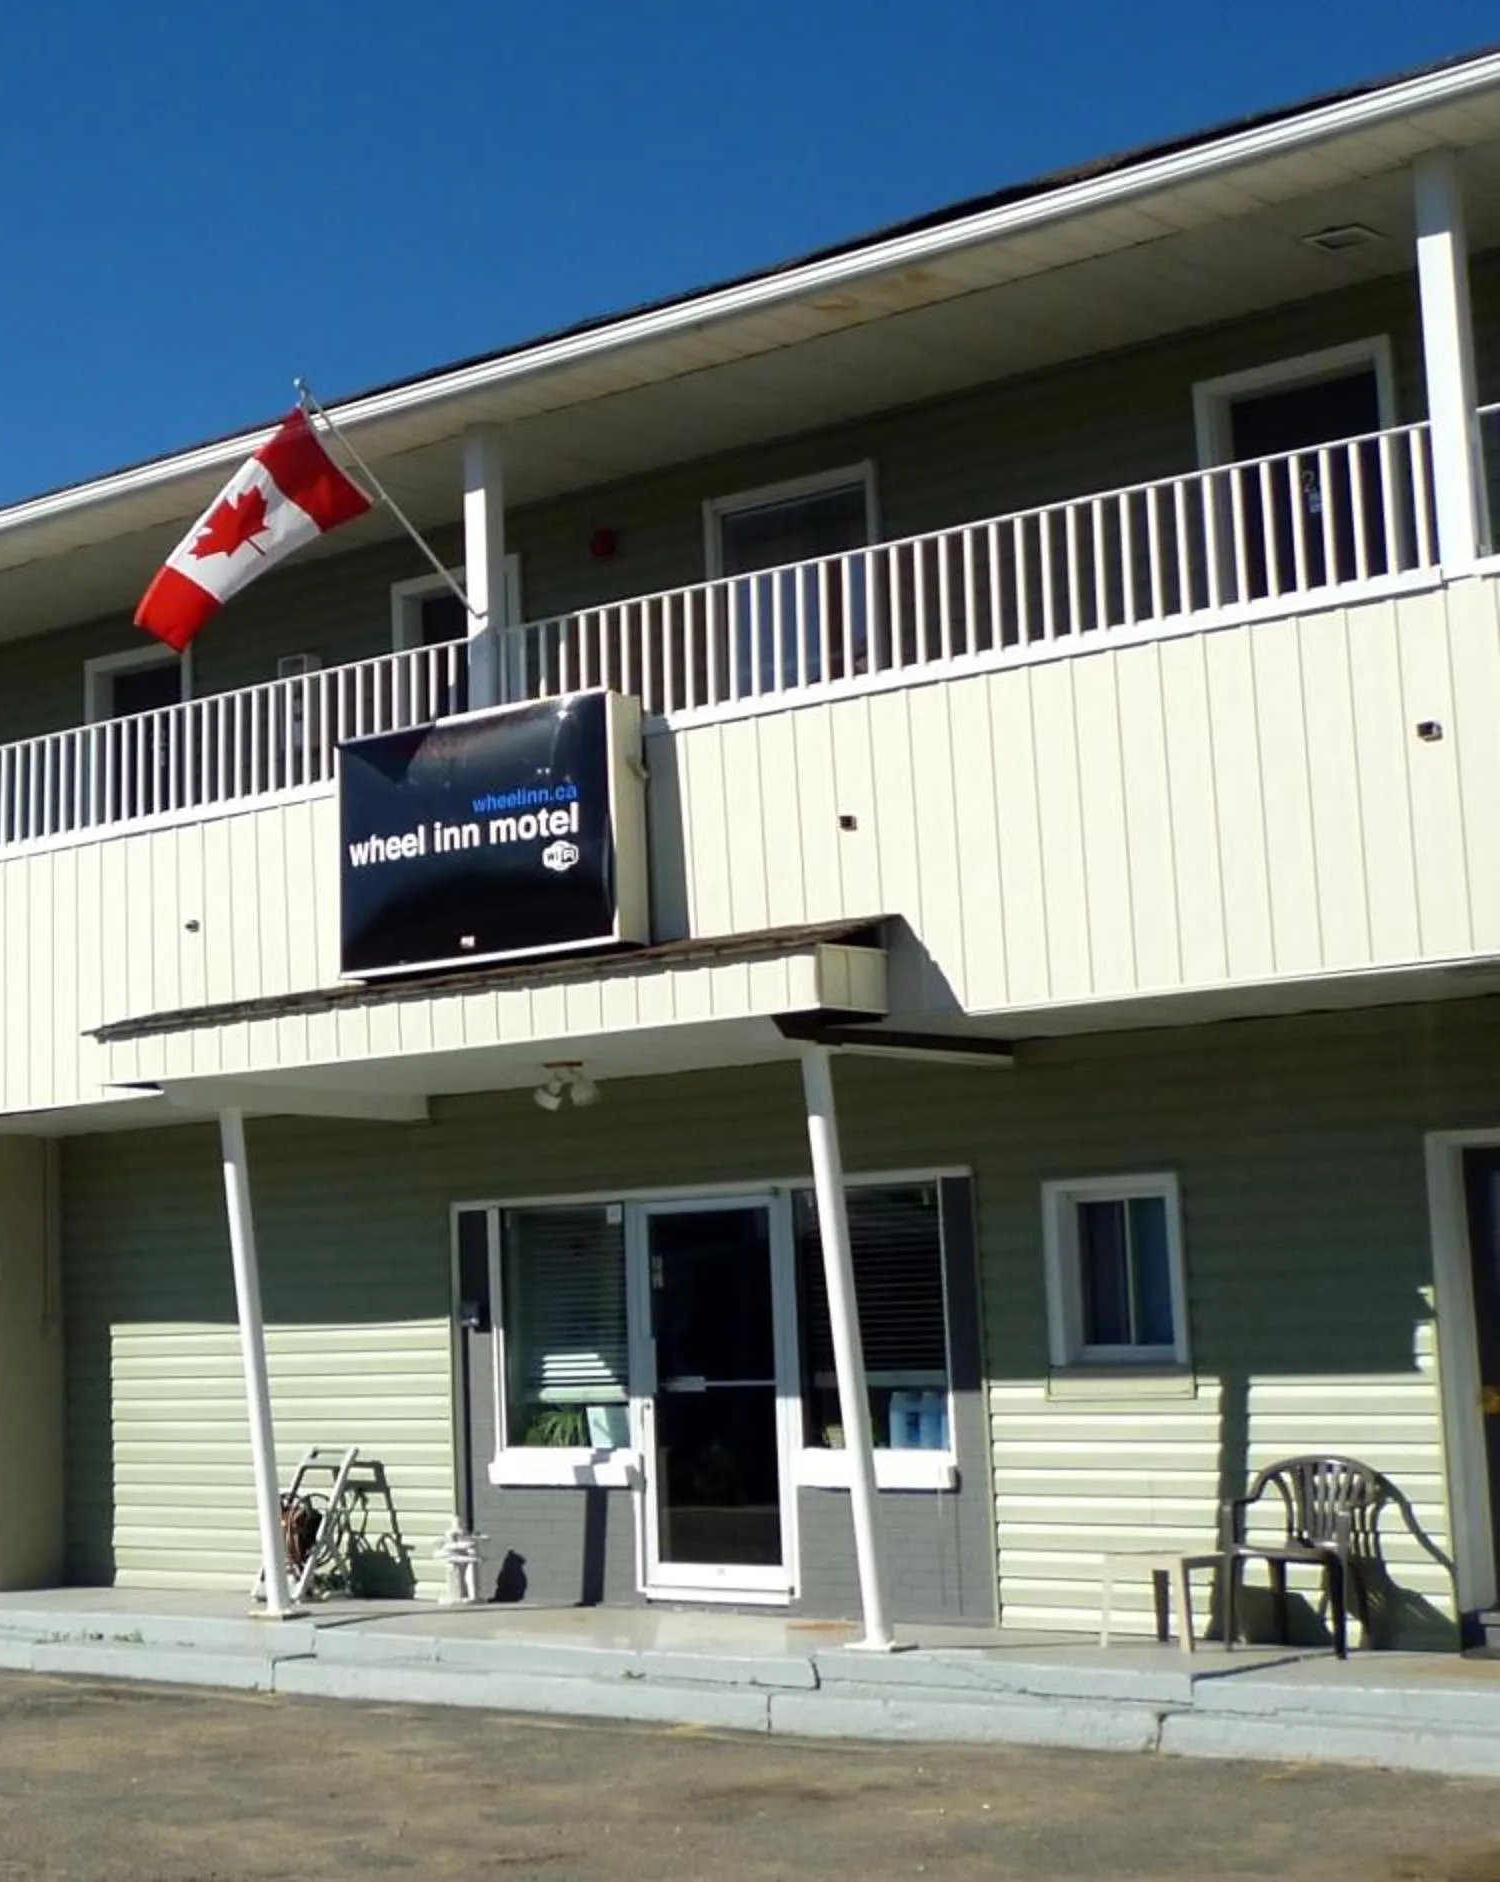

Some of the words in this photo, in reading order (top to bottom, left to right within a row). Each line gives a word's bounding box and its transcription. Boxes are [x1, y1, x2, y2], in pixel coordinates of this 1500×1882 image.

[472, 784, 578, 813] wheelinn.ca
[349, 824, 425, 867] wheel
[433, 821, 480, 853] inn
[489, 801, 579, 844] motel
